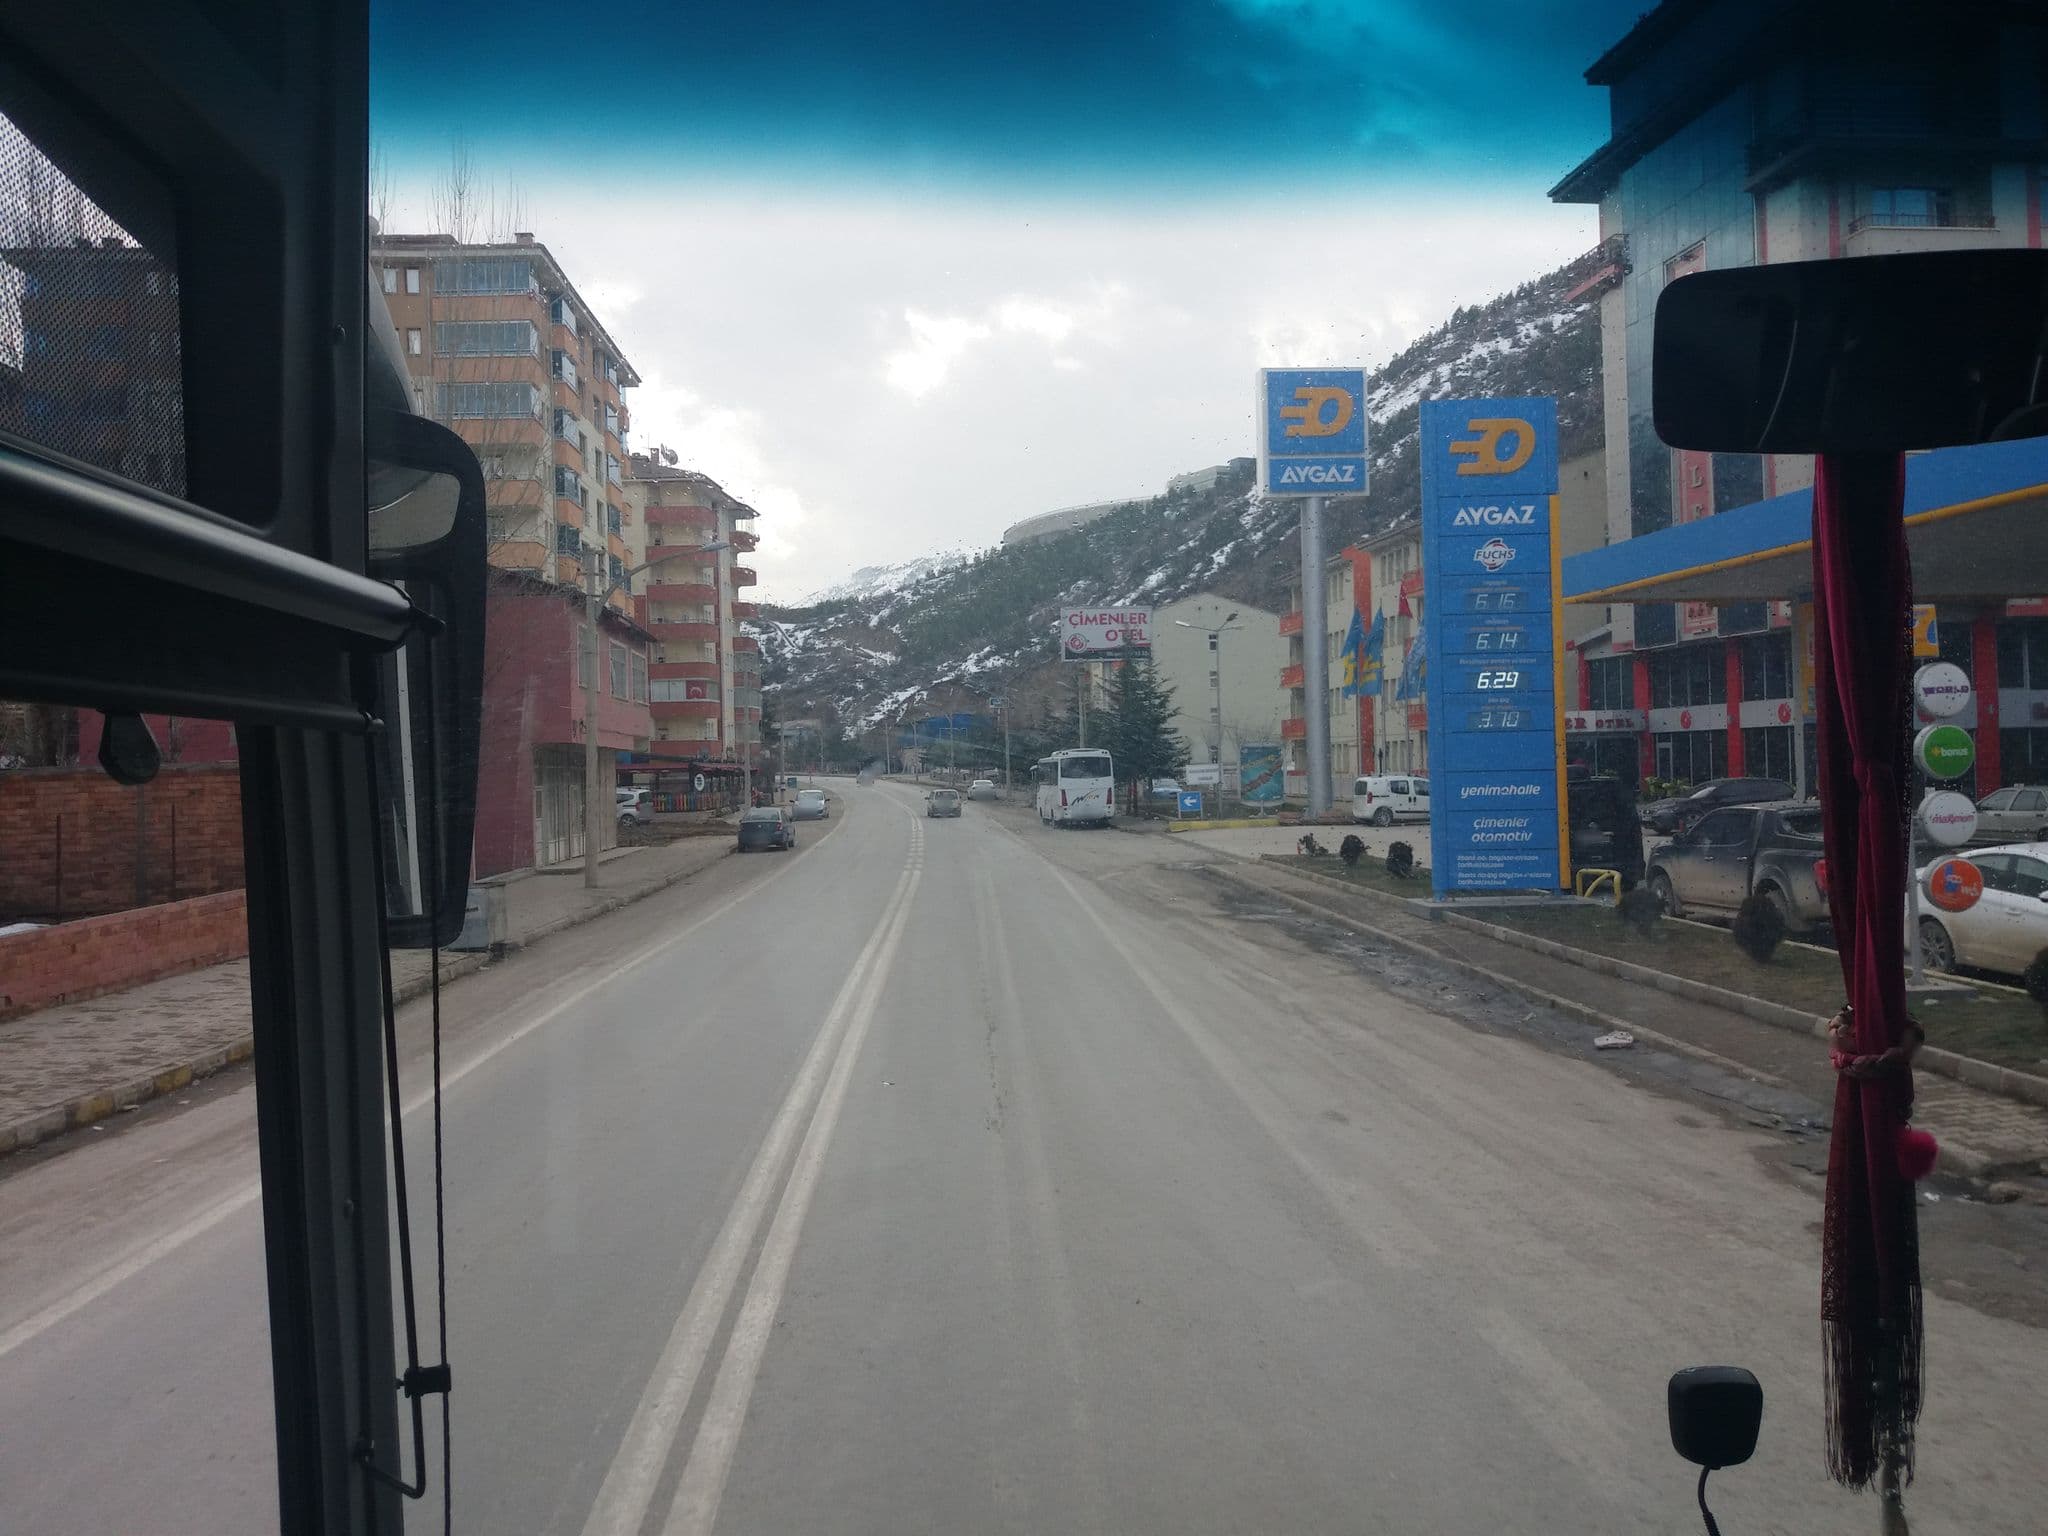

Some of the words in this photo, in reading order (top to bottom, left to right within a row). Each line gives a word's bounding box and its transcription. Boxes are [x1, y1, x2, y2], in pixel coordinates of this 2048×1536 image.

[1280, 465, 1356, 484] AYGAZ
[1453, 505, 1536, 526] AYGAZ
[1474, 548, 1515, 561] FUCHS
[1068, 611, 1147, 628] ÇİMENLER
[1105, 629, 1147, 641] OTEL
[1477, 671, 1519, 689] 6.29
[1460, 784, 1541, 799] yenimahalle
[1473, 816, 1530, 831] çimenler
[1471, 831, 1533, 843] otomotiv
